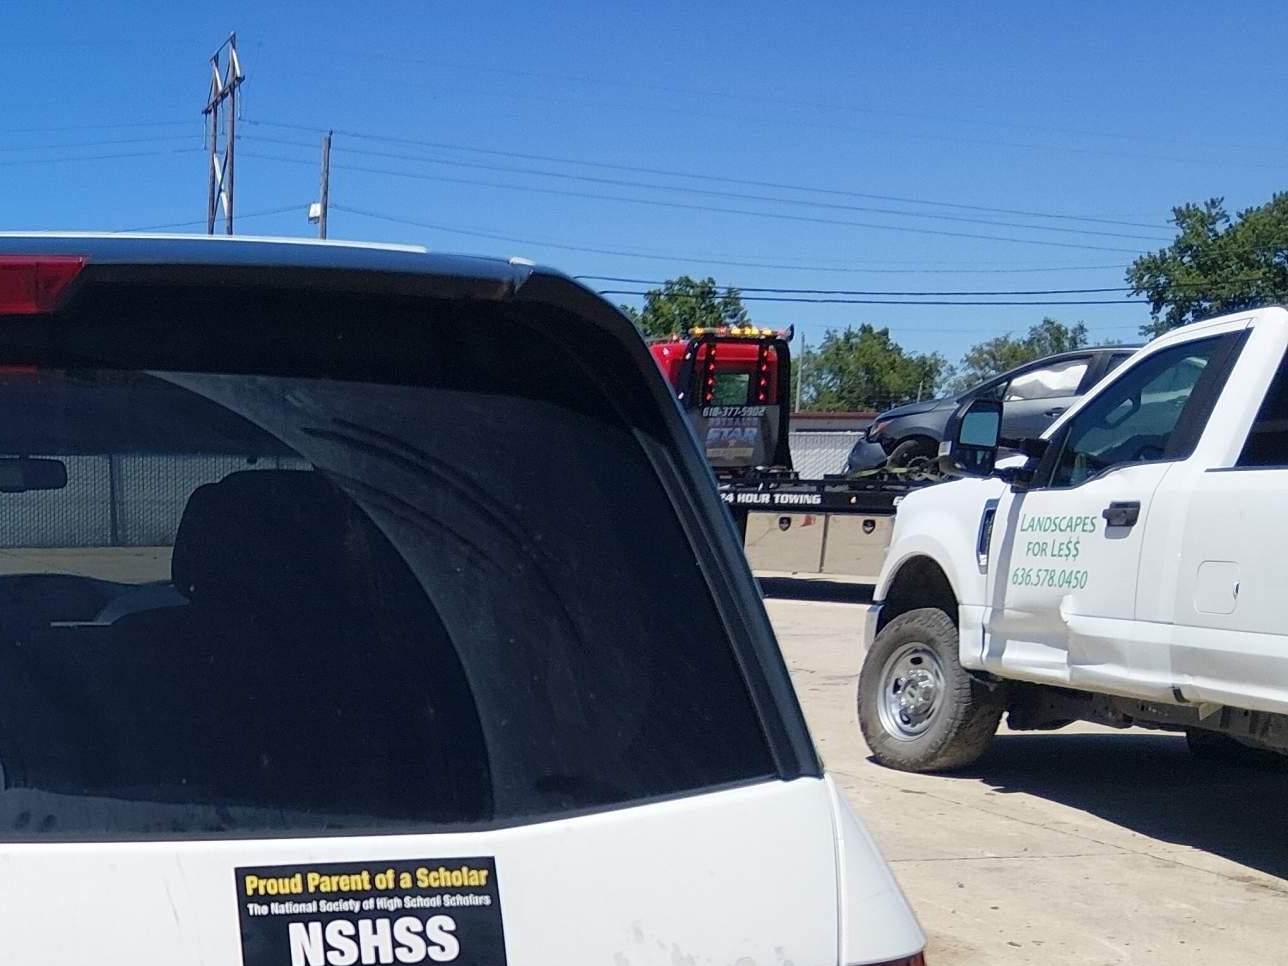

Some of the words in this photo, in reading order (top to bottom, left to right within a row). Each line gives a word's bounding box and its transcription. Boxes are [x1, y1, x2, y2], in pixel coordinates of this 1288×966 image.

[736, 493, 770, 504] HOUR
[773, 494, 821, 505] TOWING
[1020, 514, 1097, 533] LANDSCAPES
[1026, 541, 1048, 557] FOR
[1012, 567, 1088, 589] 636.578.0450
[245, 873, 303, 896] Proud
[307, 869, 372, 893] Parent
[375, 868, 396, 891] of
[399, 872, 412, 889] a
[416, 866, 489, 889] Scholar
[247, 902, 269, 917] The
[270, 899, 318, 915] National
[319, 898, 361, 914] Society
[362, 897, 375, 911] of
[376, 896, 402, 912] High
[404, 894, 442, 909] School
[443, 893, 492, 908] Scholars
